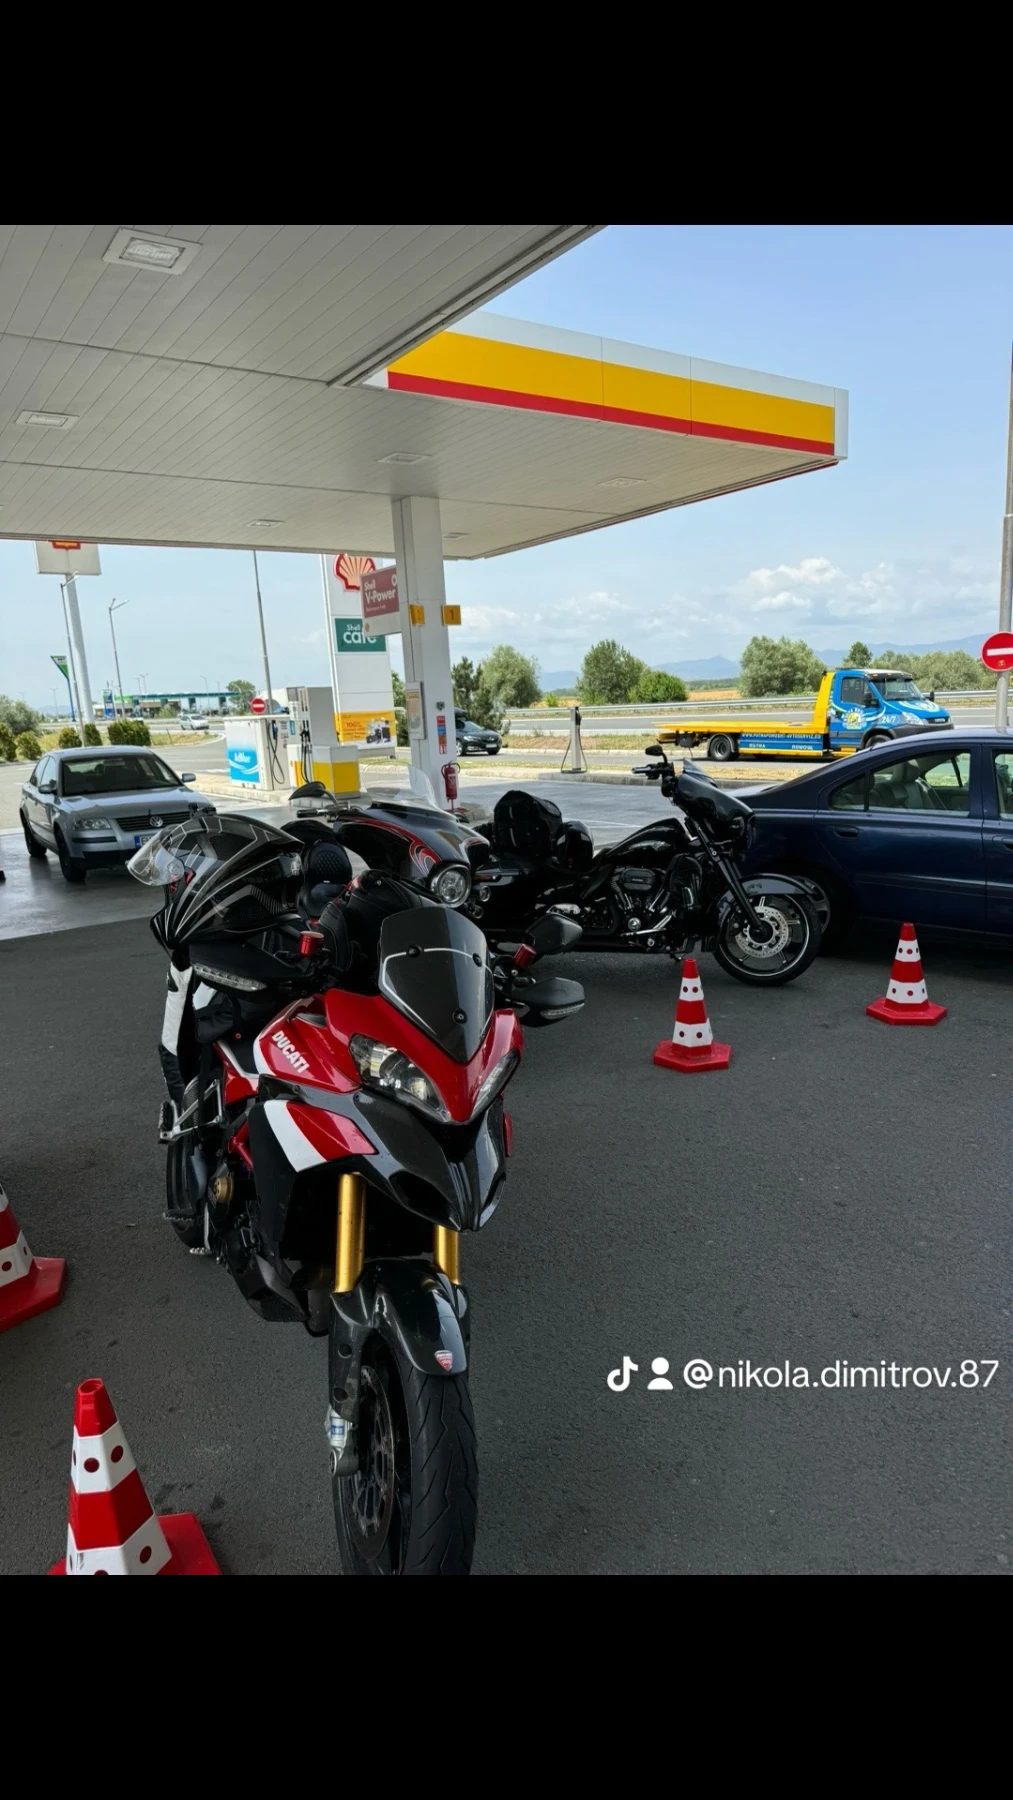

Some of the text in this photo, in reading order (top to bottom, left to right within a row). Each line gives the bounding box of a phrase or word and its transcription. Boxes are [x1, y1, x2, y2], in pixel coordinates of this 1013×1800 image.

[364, 579, 376, 591] Shell
[364, 589, 396, 604] V-Power
[449, 609, 454, 620] 1
[346, 623, 361, 631] Shell
[881, 715, 896, 724] 24/7
[271, 1030, 310, 1073] DUCATI
